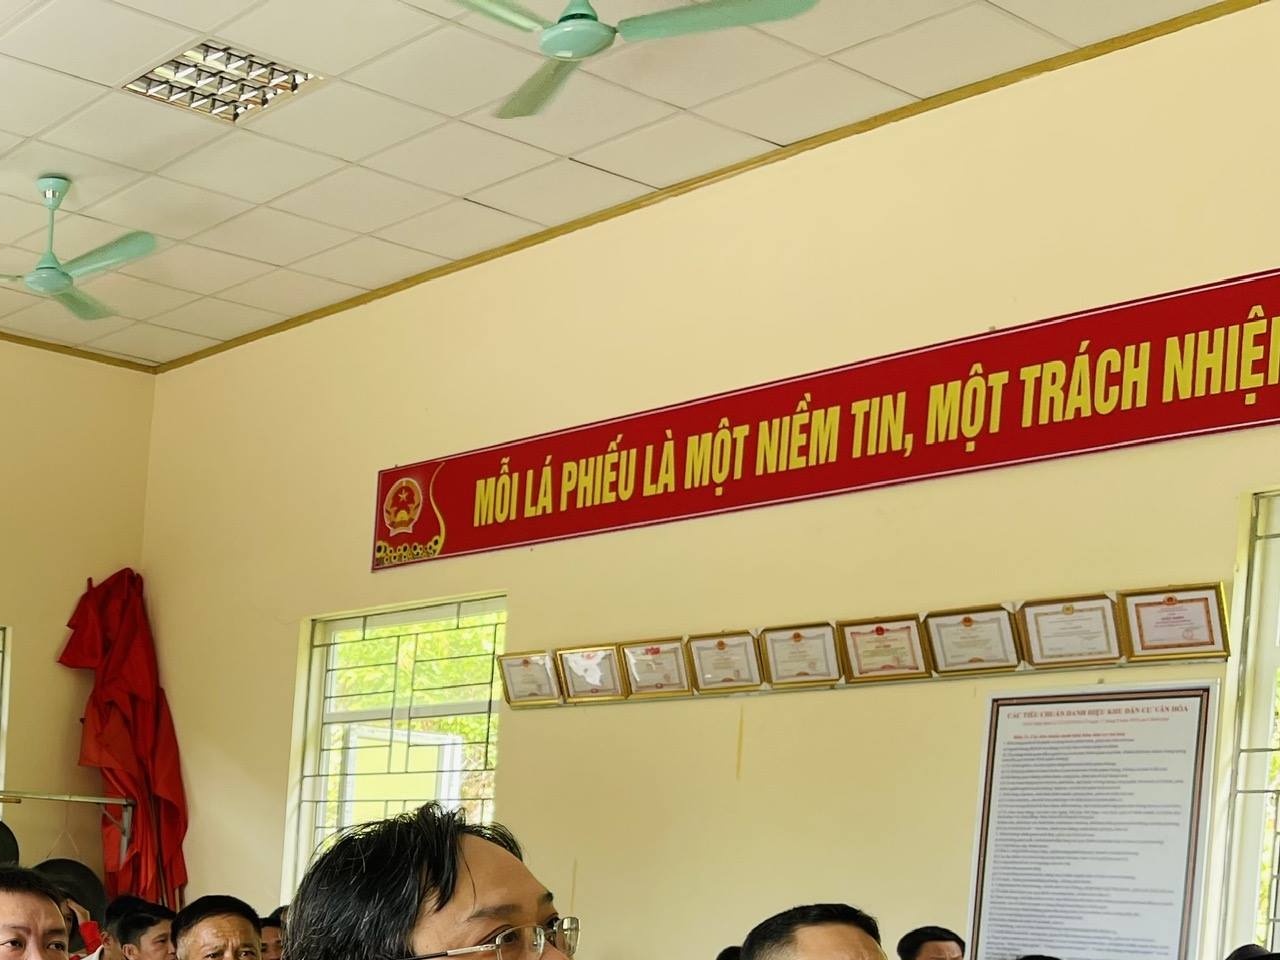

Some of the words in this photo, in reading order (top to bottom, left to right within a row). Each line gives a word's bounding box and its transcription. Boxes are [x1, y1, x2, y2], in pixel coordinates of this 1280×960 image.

[473, 456, 519, 527] MỖI
[523, 455, 553, 518] LÁ
[560, 434, 637, 512] PHIẾU
[642, 429, 675, 497] LÀ
[684, 417, 750, 496] MỘT
[755, 392, 841, 476] NIỀM
[851, 391, 913, 458] TIN,
[925, 363, 1009, 452] MỘT
[1019, 339, 1151, 428] TRÁCH
[1162, 304, 1280, 405] NHIỆ
